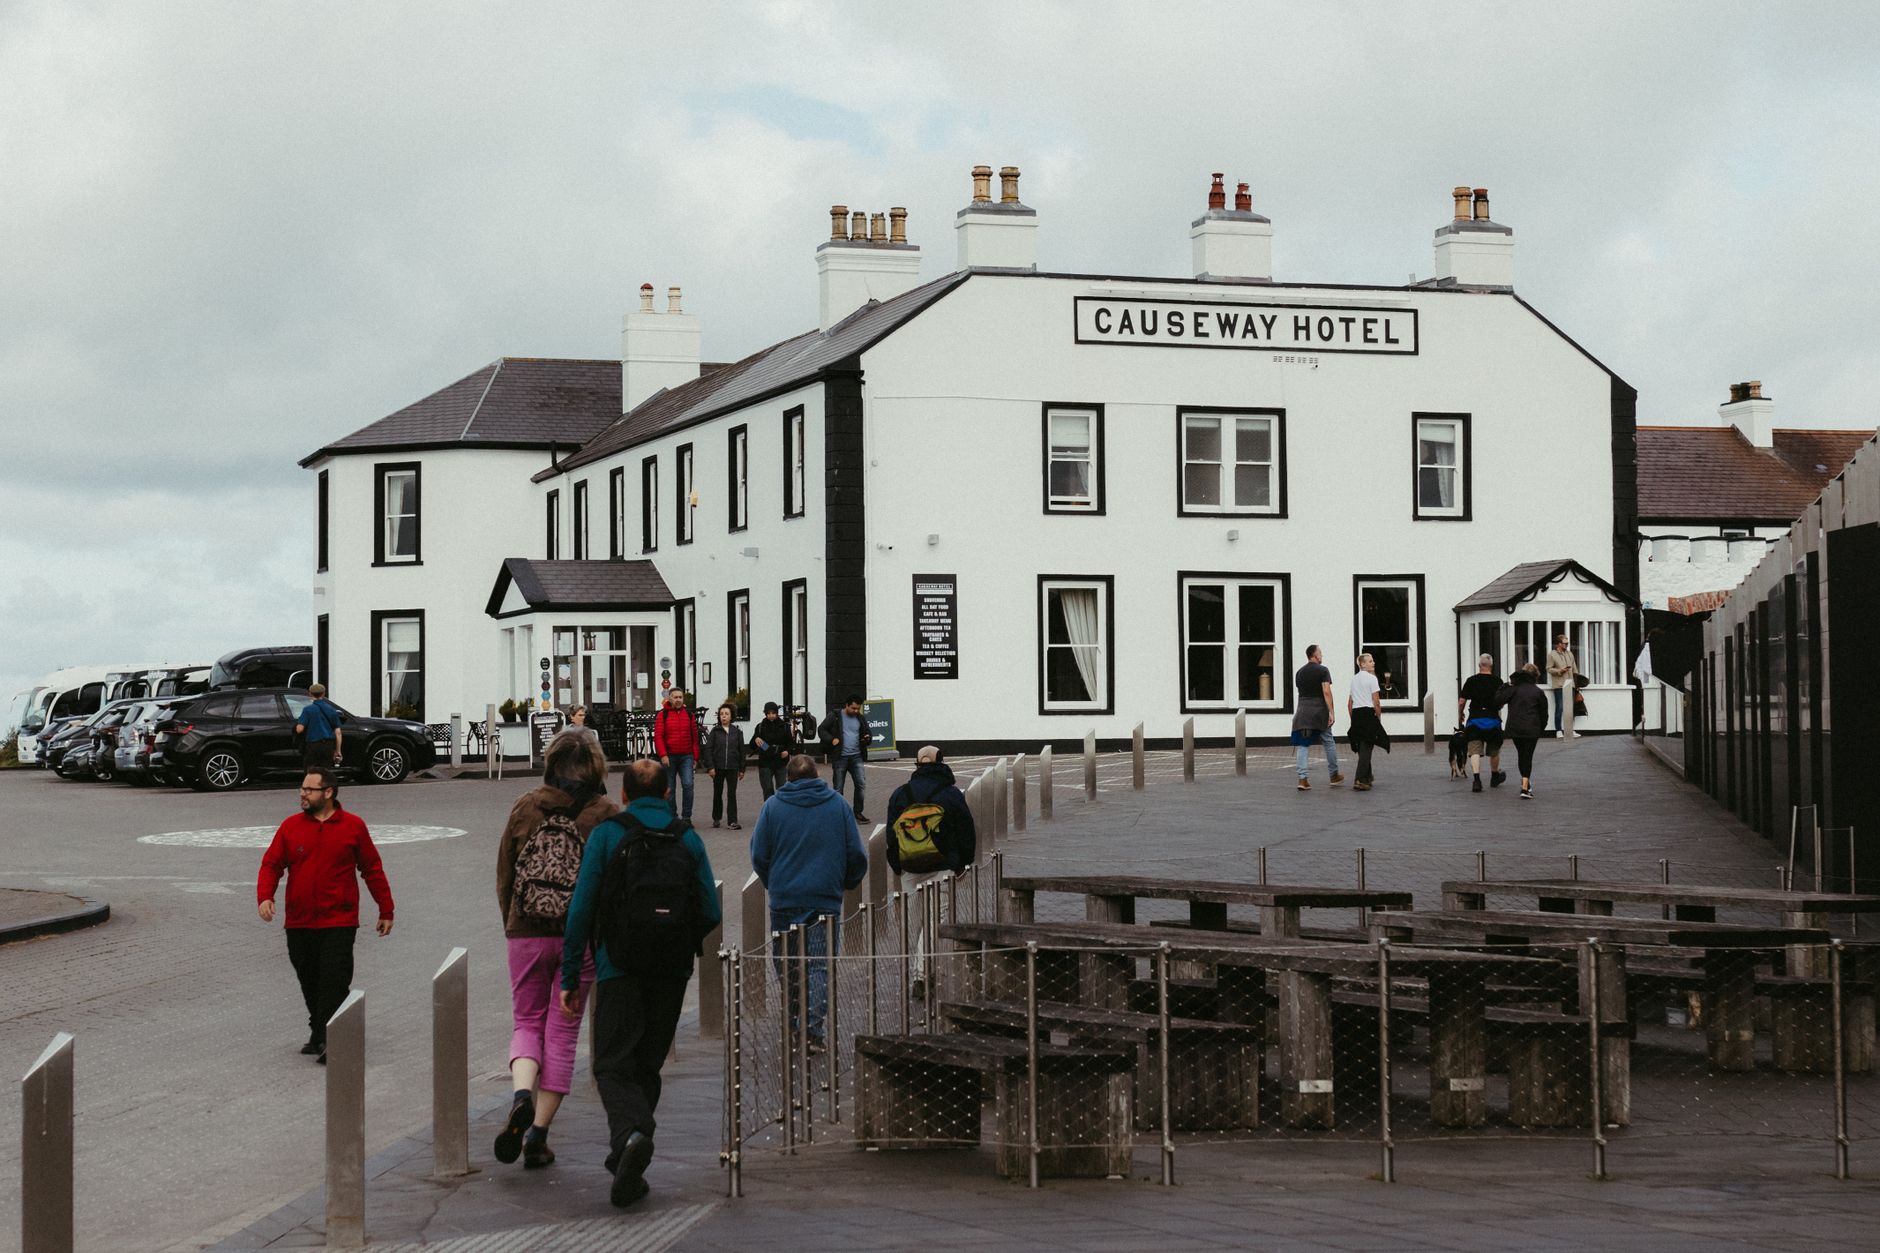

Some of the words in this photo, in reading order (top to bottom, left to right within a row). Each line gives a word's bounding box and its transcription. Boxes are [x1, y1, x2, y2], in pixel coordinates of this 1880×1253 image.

[1095, 307, 1277, 340] CAUSEWAY
[1293, 315, 1399, 344] HOTEL
[867, 720, 888, 728] oilets
